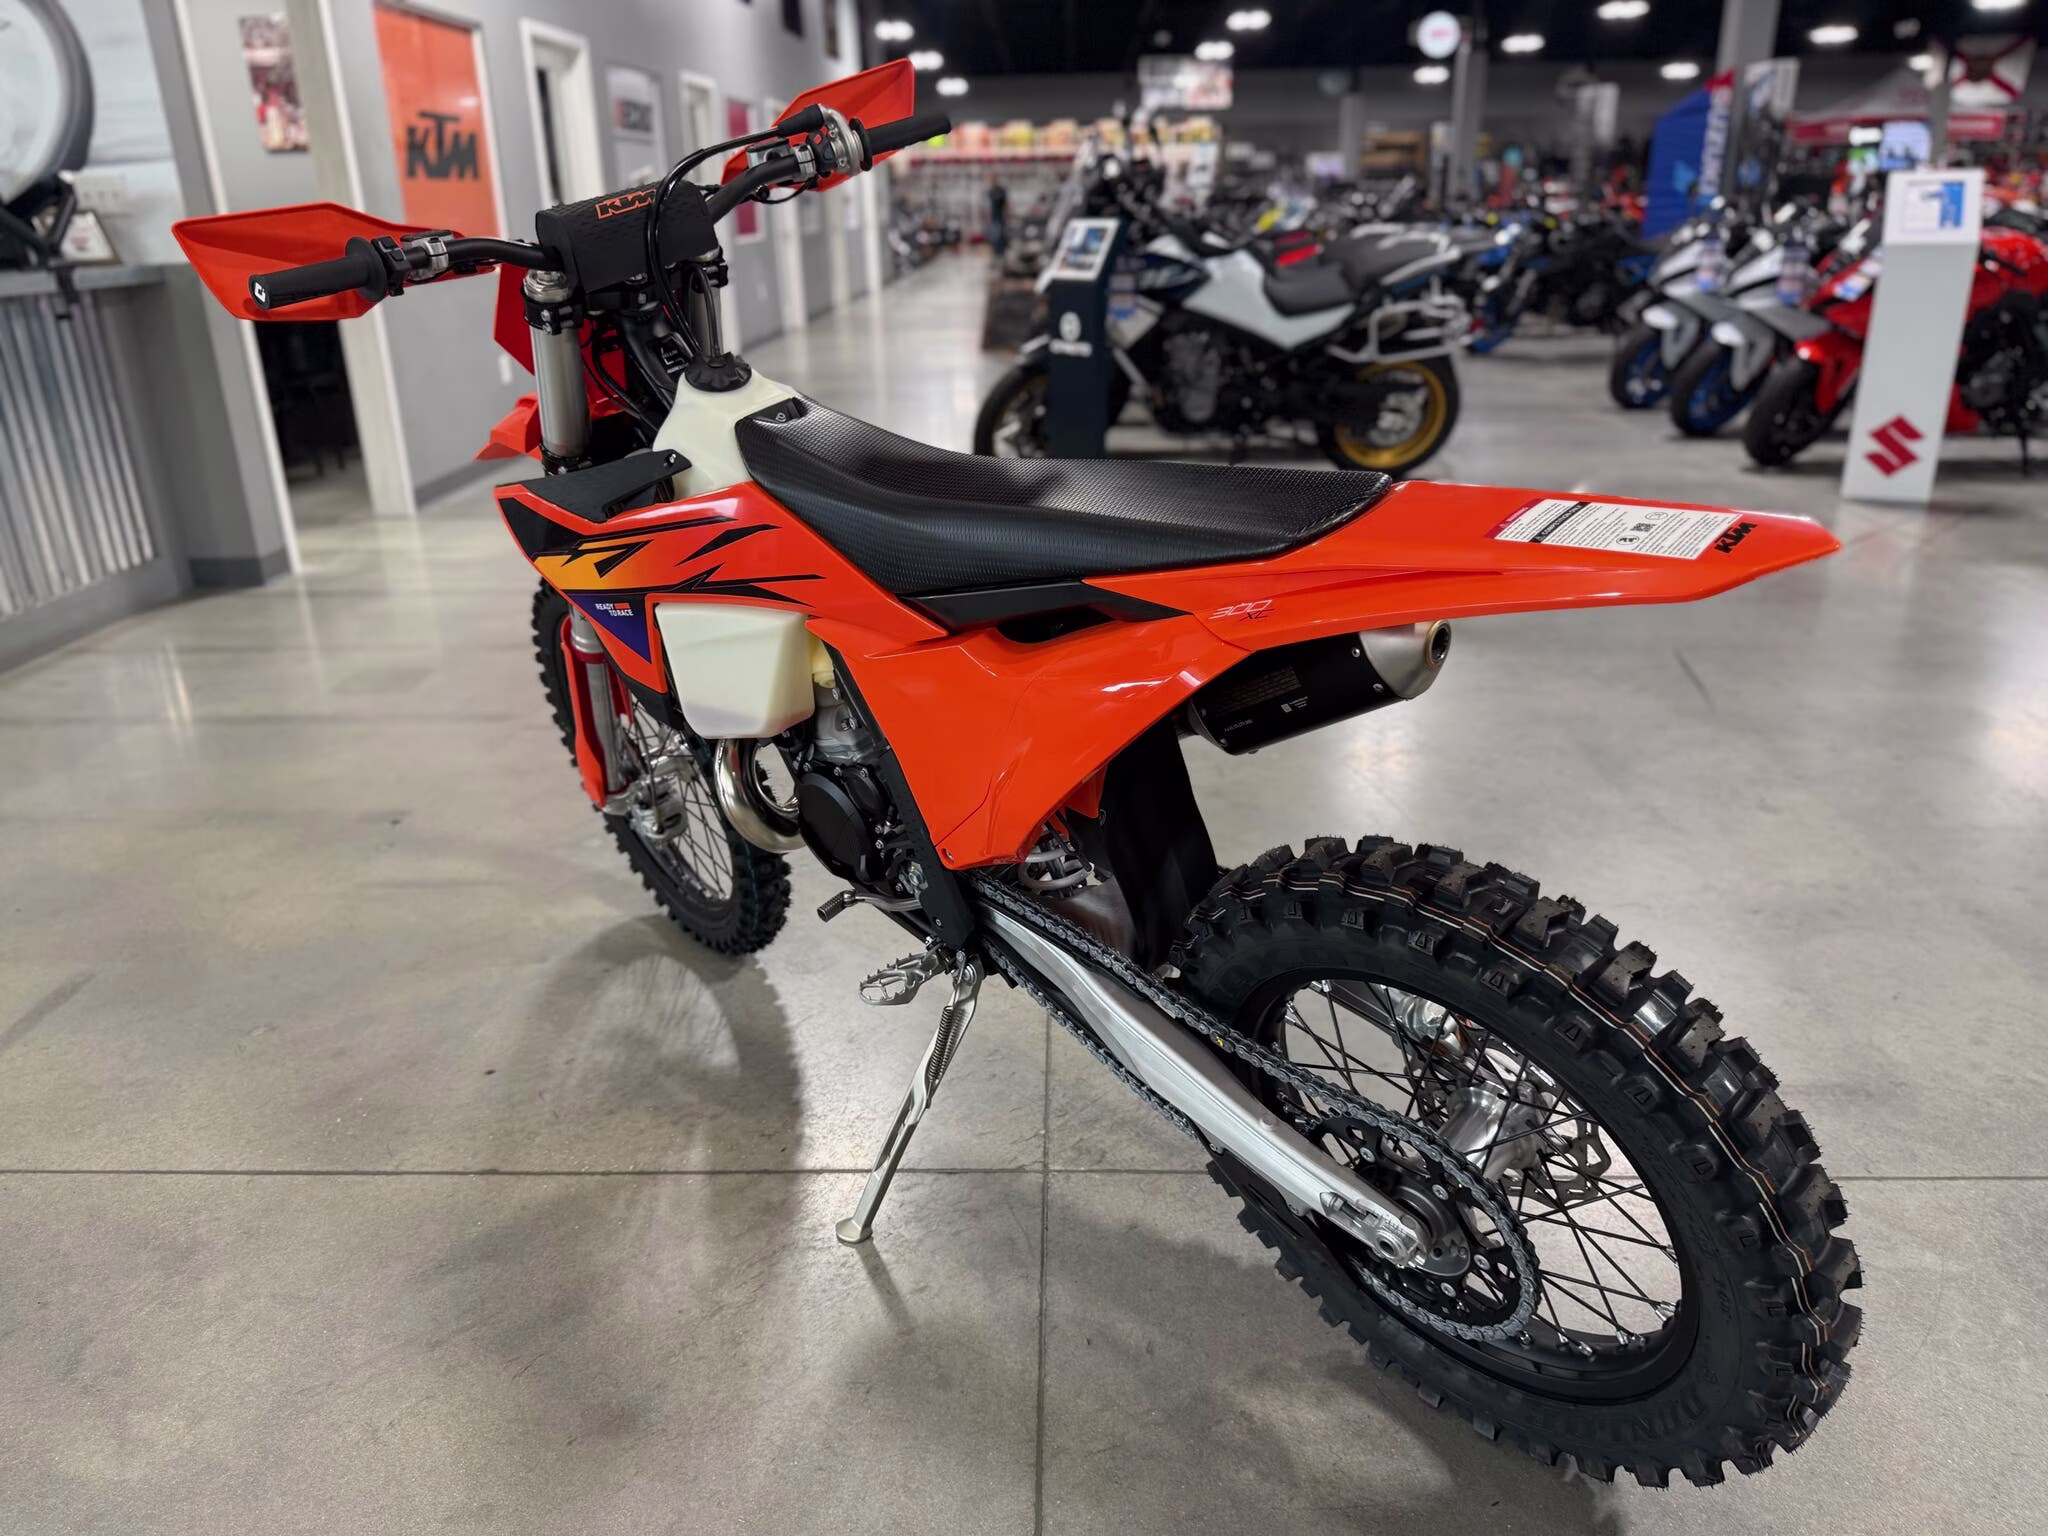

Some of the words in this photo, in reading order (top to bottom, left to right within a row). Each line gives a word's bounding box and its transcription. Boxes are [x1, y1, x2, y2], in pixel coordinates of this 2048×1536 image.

[406, 110, 479, 181] KTM
[595, 188, 657, 219] KTM
[1714, 522, 1758, 553] KTM
[609, 609, 618, 617] TO
[618, 609, 634, 617] RACE
[1208, 599, 1273, 620] 300
